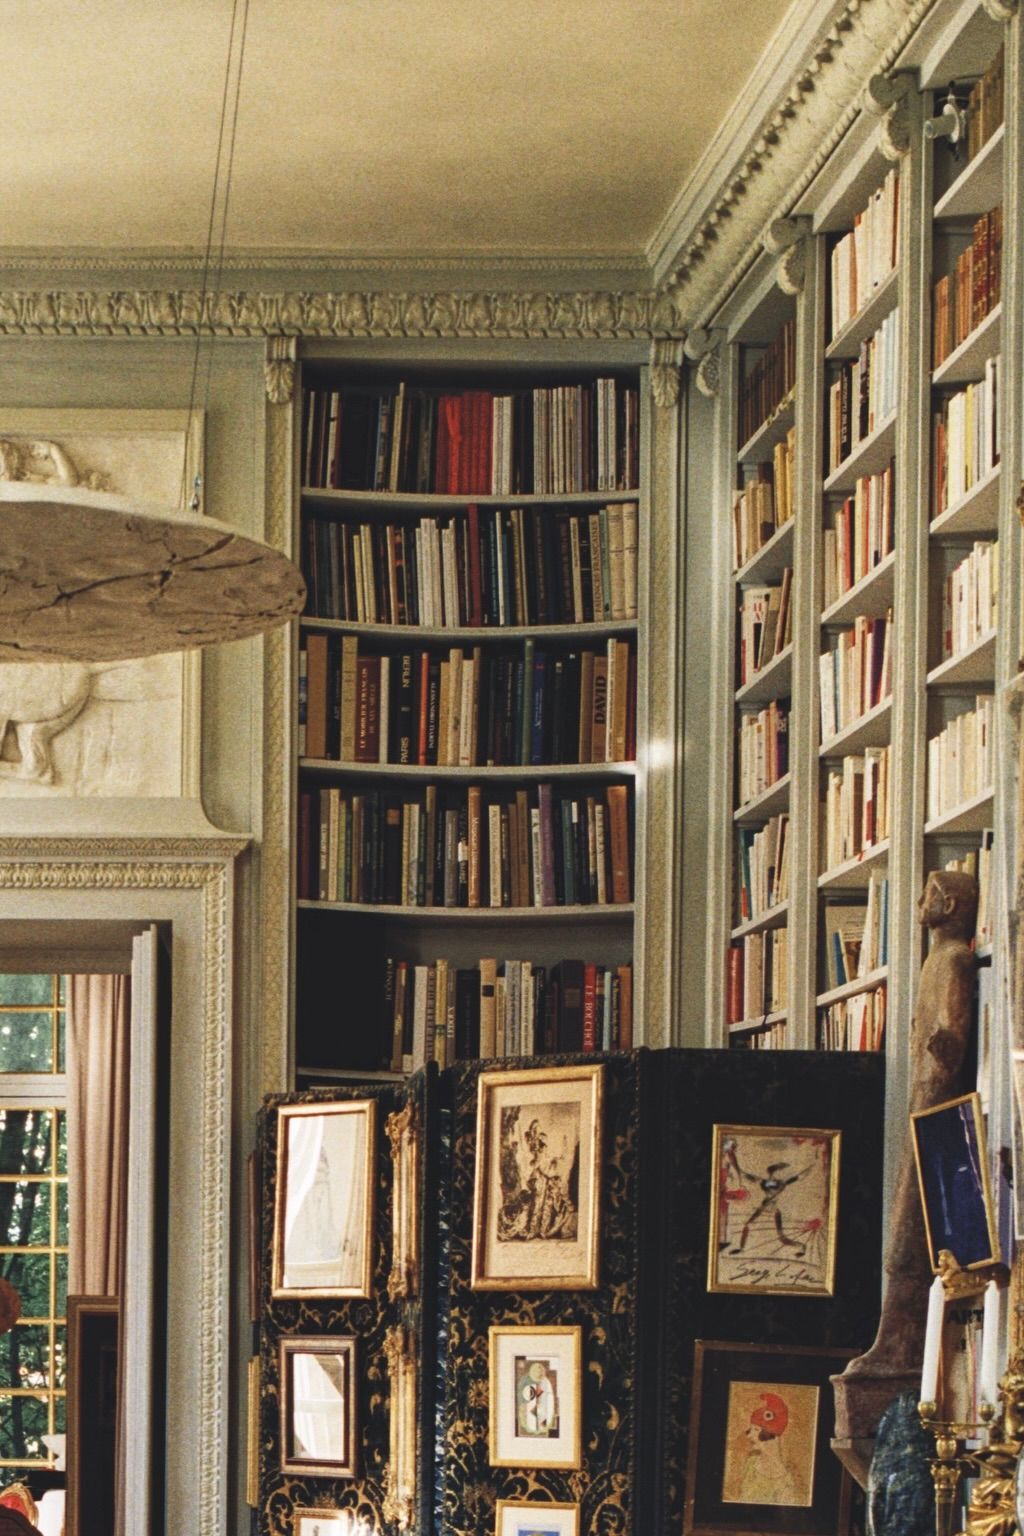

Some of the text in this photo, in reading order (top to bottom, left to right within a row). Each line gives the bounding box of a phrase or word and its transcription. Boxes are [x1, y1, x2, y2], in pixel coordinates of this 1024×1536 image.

[402, 656, 410, 688] BERLIN
[594, 676, 606, 724] DAVID
[401, 737, 409, 763] PARIS
